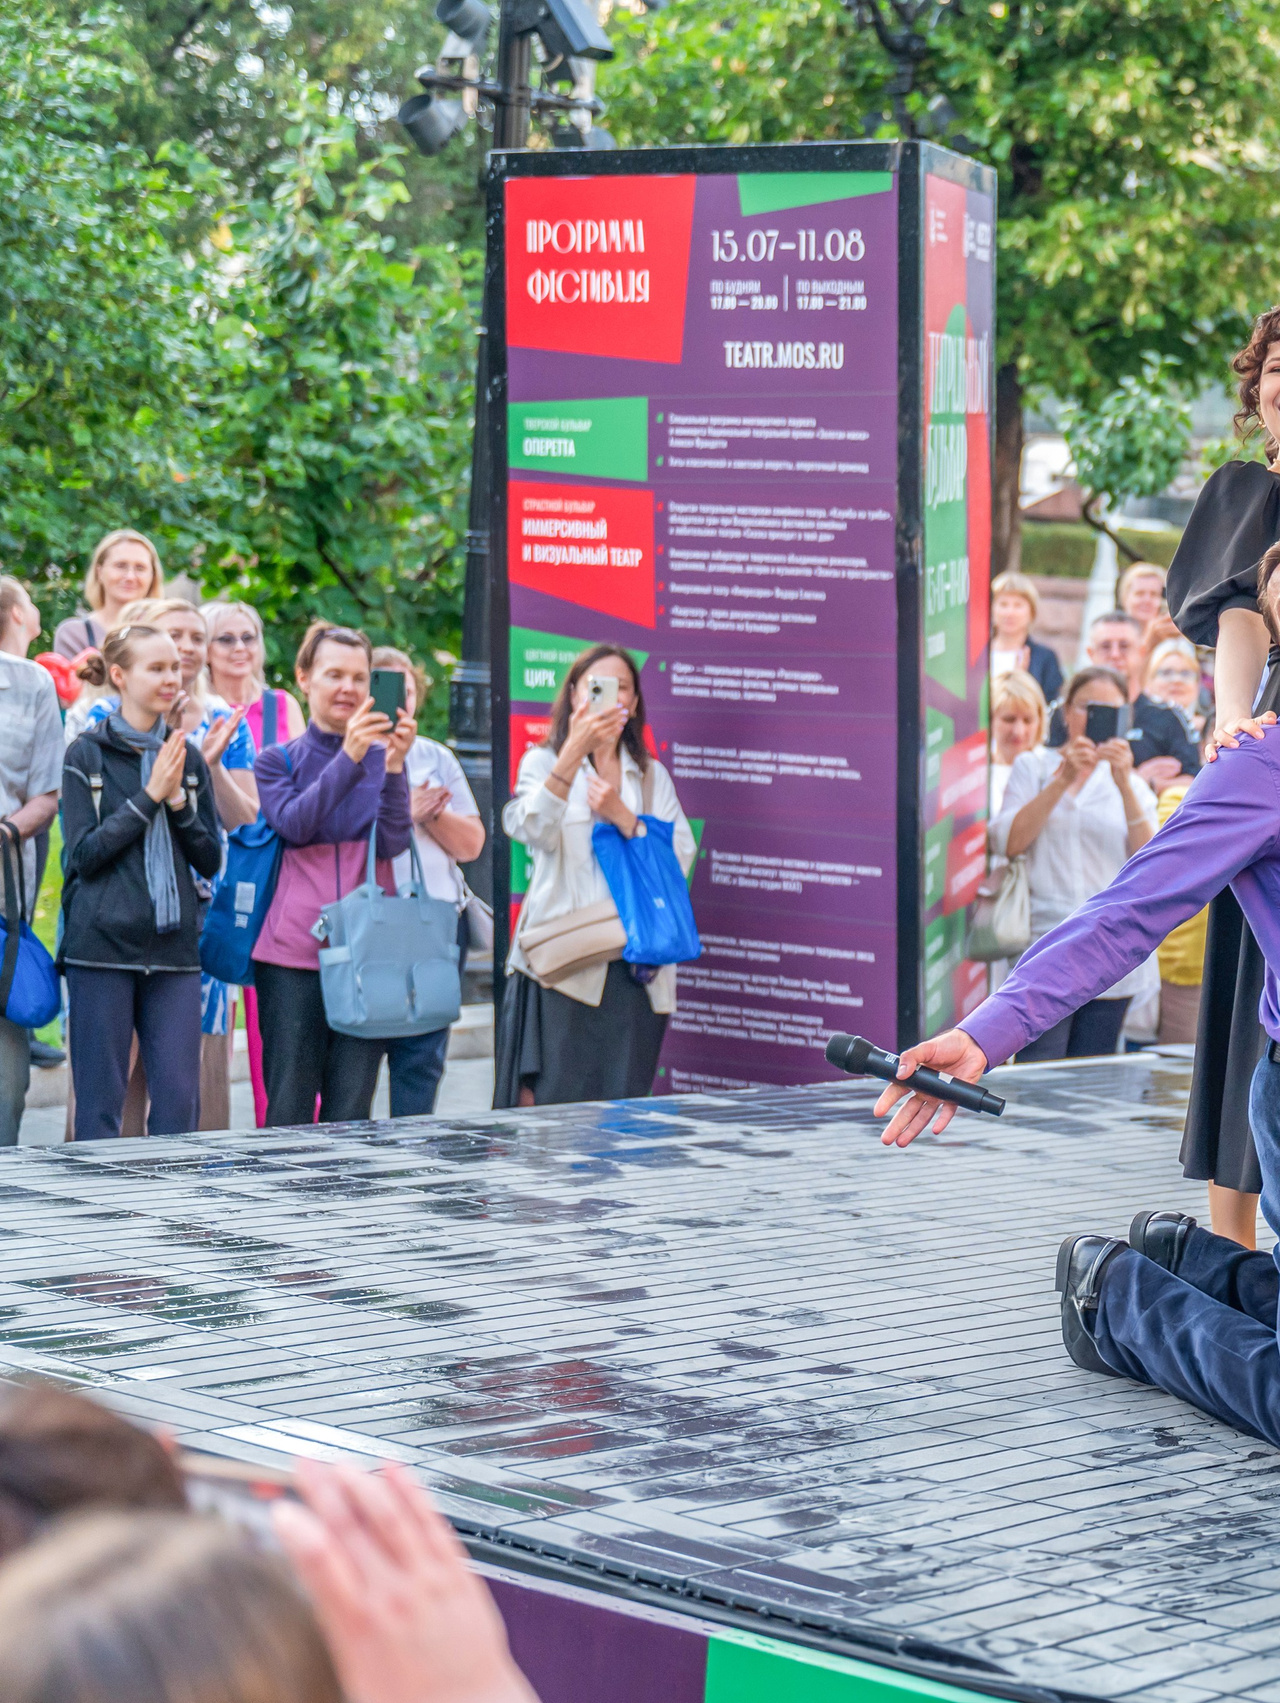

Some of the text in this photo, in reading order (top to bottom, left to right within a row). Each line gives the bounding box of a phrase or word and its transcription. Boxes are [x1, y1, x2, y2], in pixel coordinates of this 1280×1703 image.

[710, 279, 761, 295] ПО БУДНЯМ
[796, 279, 865, 296] ПО ВЫХОДНЫМ
[710, 295, 737, 310] 17.00
[796, 295, 824, 310] 17.00
[723, 341, 845, 370] TEATR.MOS.RU
[522, 437, 576, 457] ОПЕРЕТТА
[522, 517, 607, 539] ИММЕРСИВНЫЙ
[522, 543, 531, 562] И
[533, 544, 608, 566] ВИЗУАЛЬНЫЙ
[610, 547, 643, 568] ТЕАТР
[524, 667, 556, 689] ЦИРК
